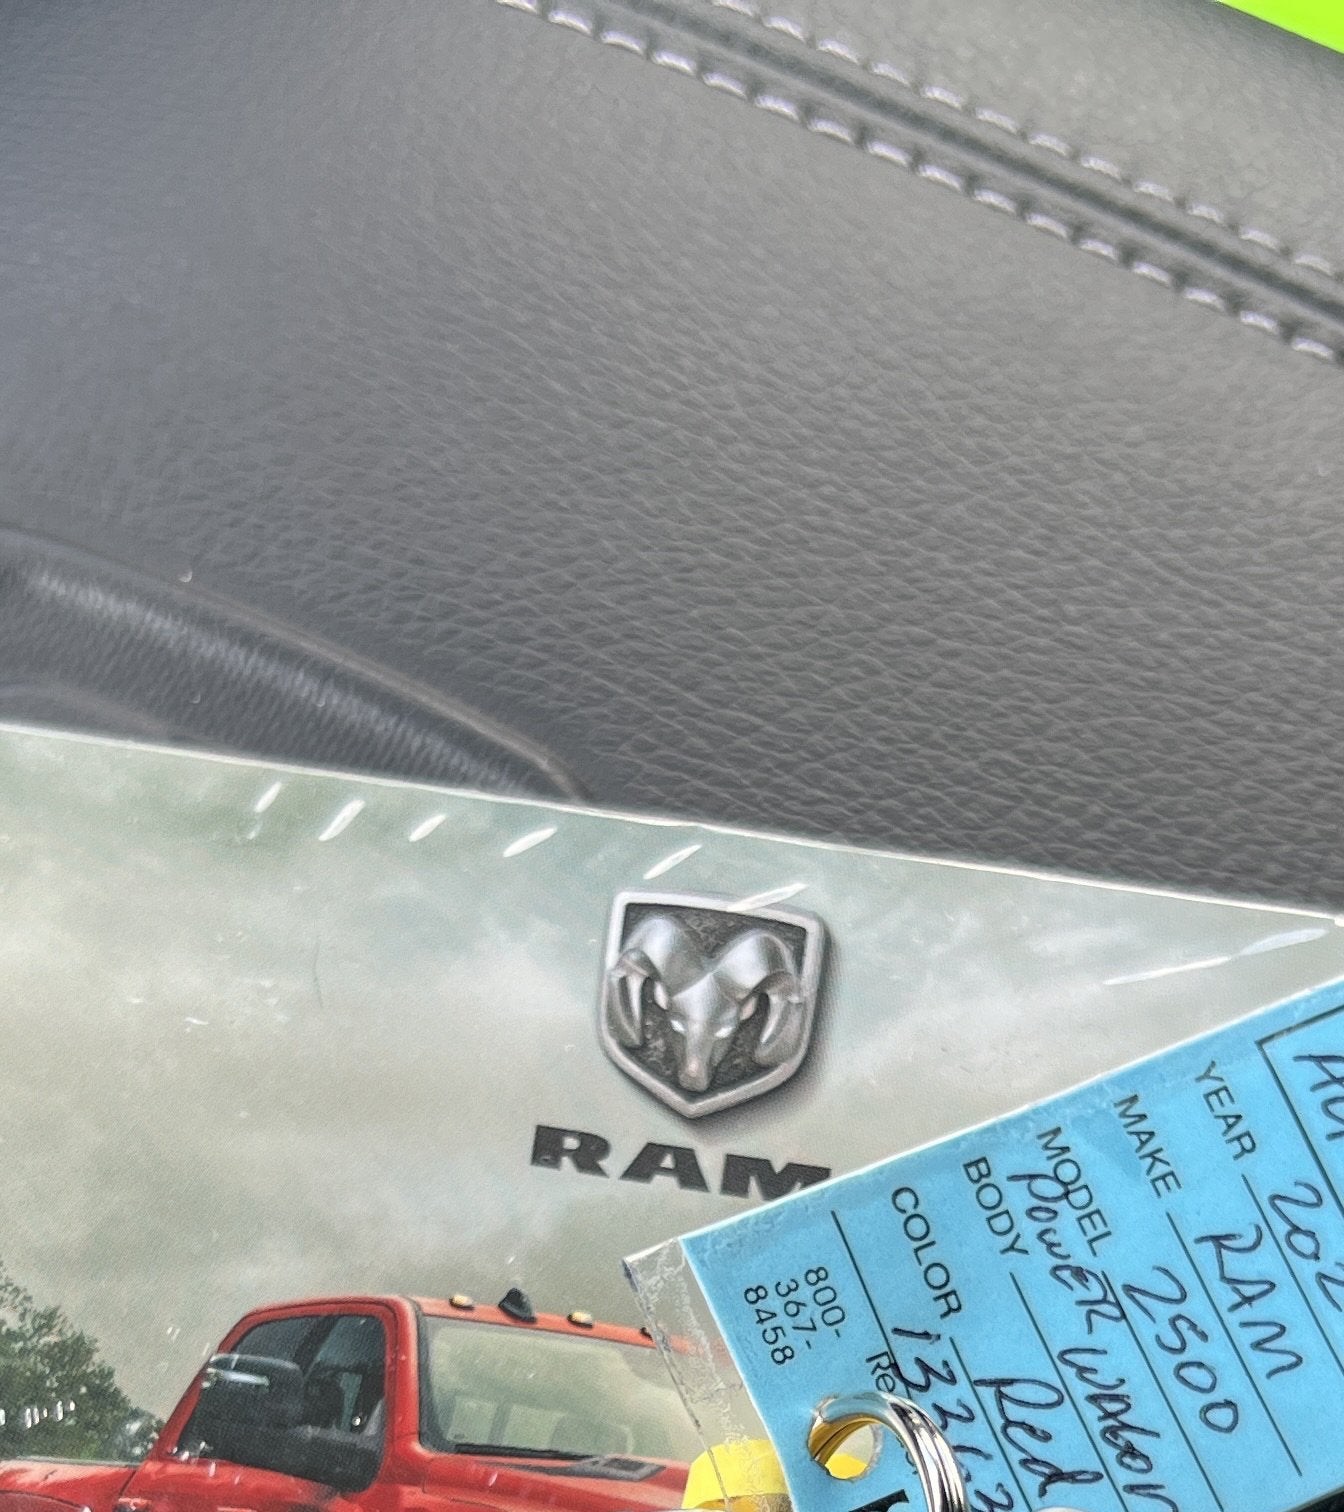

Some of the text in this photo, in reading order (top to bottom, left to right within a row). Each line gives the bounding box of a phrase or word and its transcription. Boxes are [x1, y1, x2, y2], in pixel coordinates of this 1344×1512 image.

[1194, 1060, 1258, 1161] YEAR
[531, 1124, 832, 1201] RAM
[962, 1155, 1030, 1258] BODY
[1037, 1125, 1239, 1434] MODEL 2500
[1113, 1093, 1303, 1380] MAKE RAM
[743, 1286, 796, 1366] 8458
[774, 1277, 818, 1351] 367-
[803, 1265, 846, 1340] 800-
[890, 1185, 964, 1319] COLOR
[973, 1377, 1104, 1499] Red
